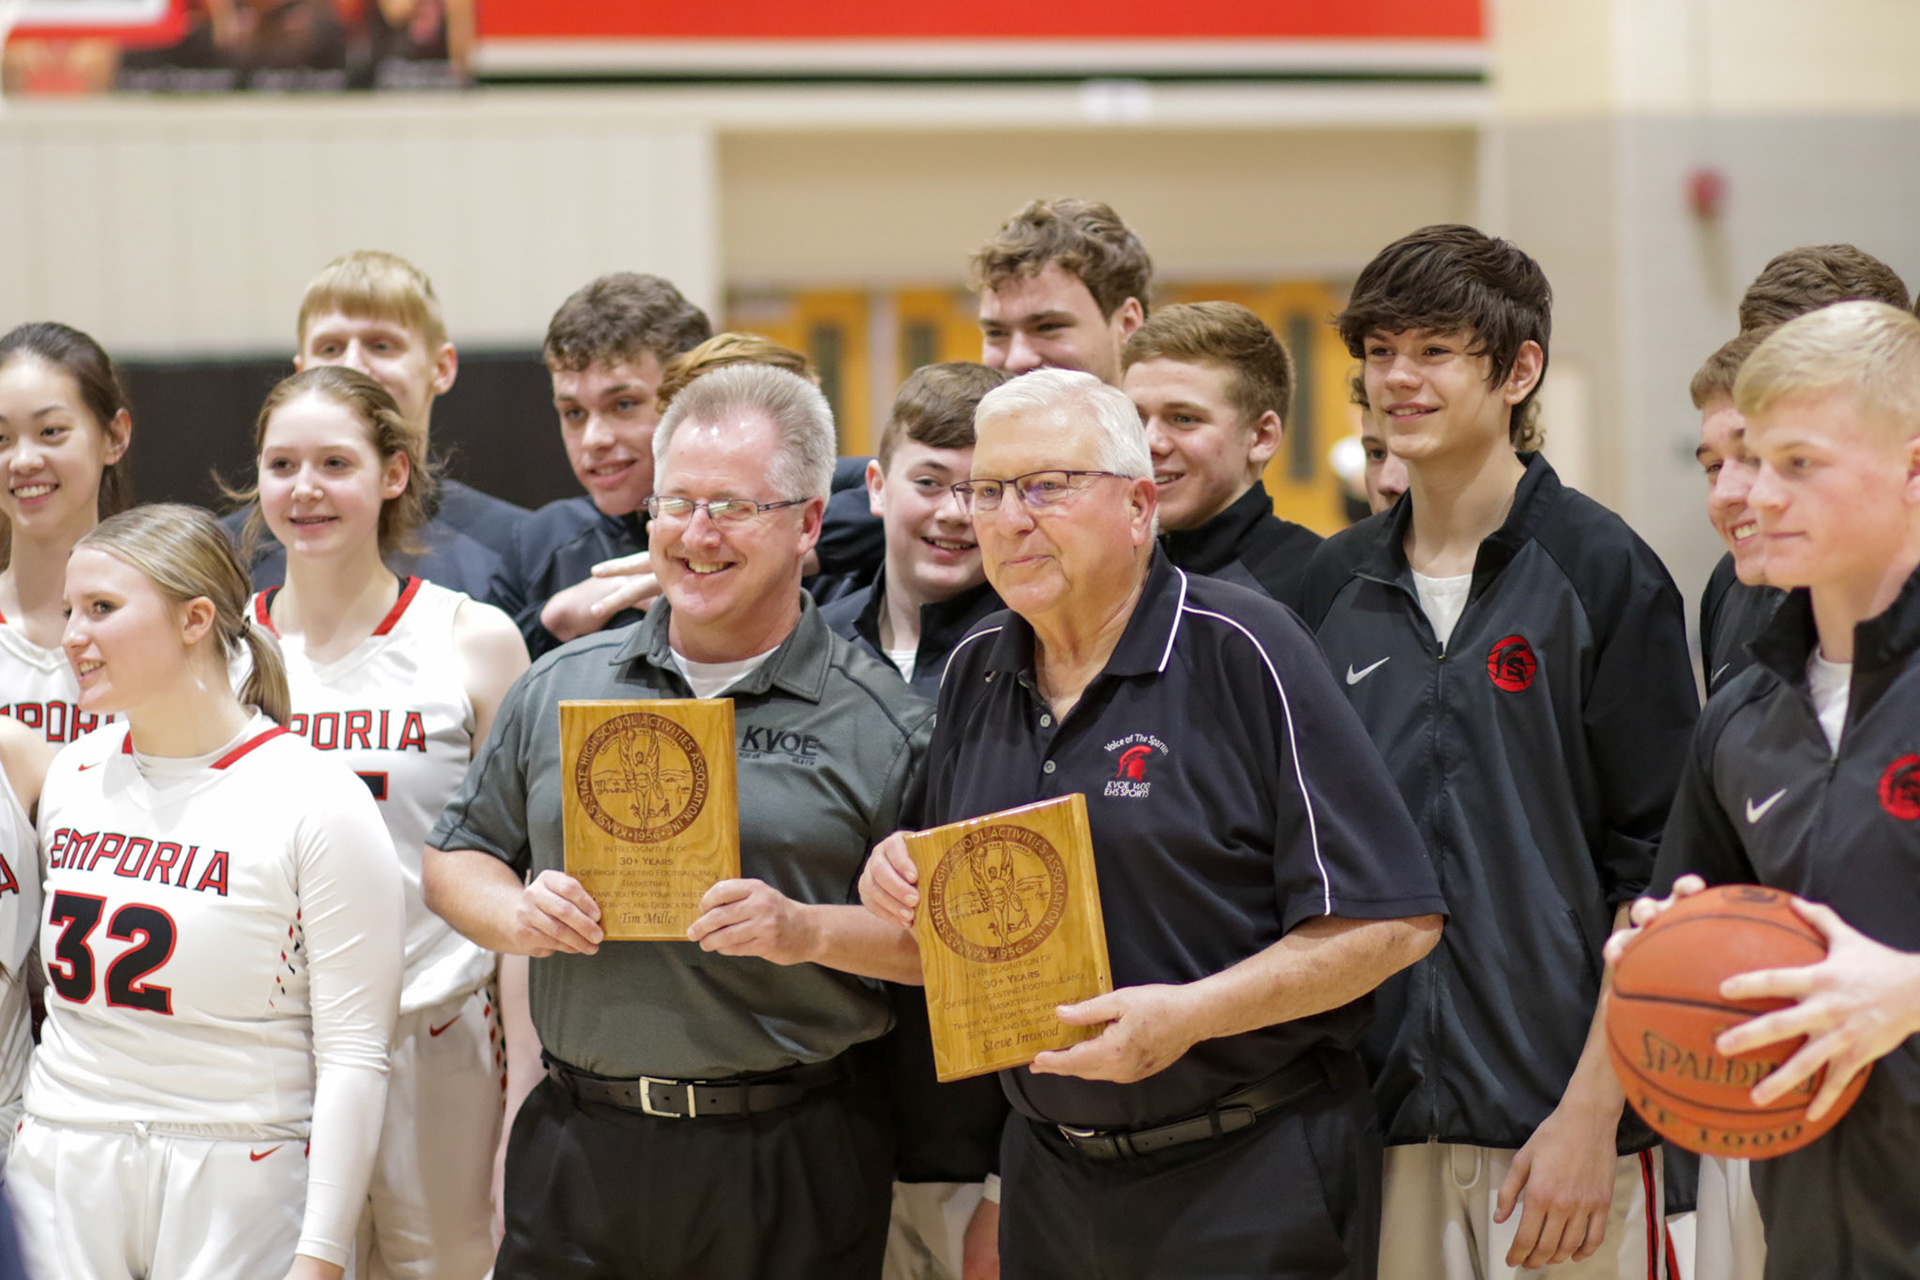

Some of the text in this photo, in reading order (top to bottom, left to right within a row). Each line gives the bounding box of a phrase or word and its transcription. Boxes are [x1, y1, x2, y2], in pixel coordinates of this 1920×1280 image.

[597, 716, 637, 741] SCHOOL
[641, 716, 695, 750] ACTIVITIES
[742, 725, 819, 756] KVOE
[1104, 738, 1125, 752] Voice
[1125, 734, 1133, 744] of
[1135, 733, 1148, 743] The
[580, 740, 598, 767] HIGH
[578, 771, 593, 804] STATE
[1104, 787, 1149, 798] EHS SPORTS
[1107, 780, 1130, 789] KVOE
[588, 804, 627, 839] KANSAS
[634, 831, 660, 842] 1956
[945, 831, 986, 864] SCHOOL
[991, 827, 1048, 855] ACTIVITIES
[50, 828, 229, 897] EMPORIA
[619, 856, 674, 866] 30+ YEARS
[933, 865, 950, 893] HIGH
[620, 911, 680, 925] Tim Miller
[931, 899, 948, 933] STATE
[48, 889, 177, 1016] 32
[996, 945, 1024, 959] 1956
[984, 970, 1041, 990] 30+ YEARS
[981, 1021, 1061, 1054] Steve Inwood
